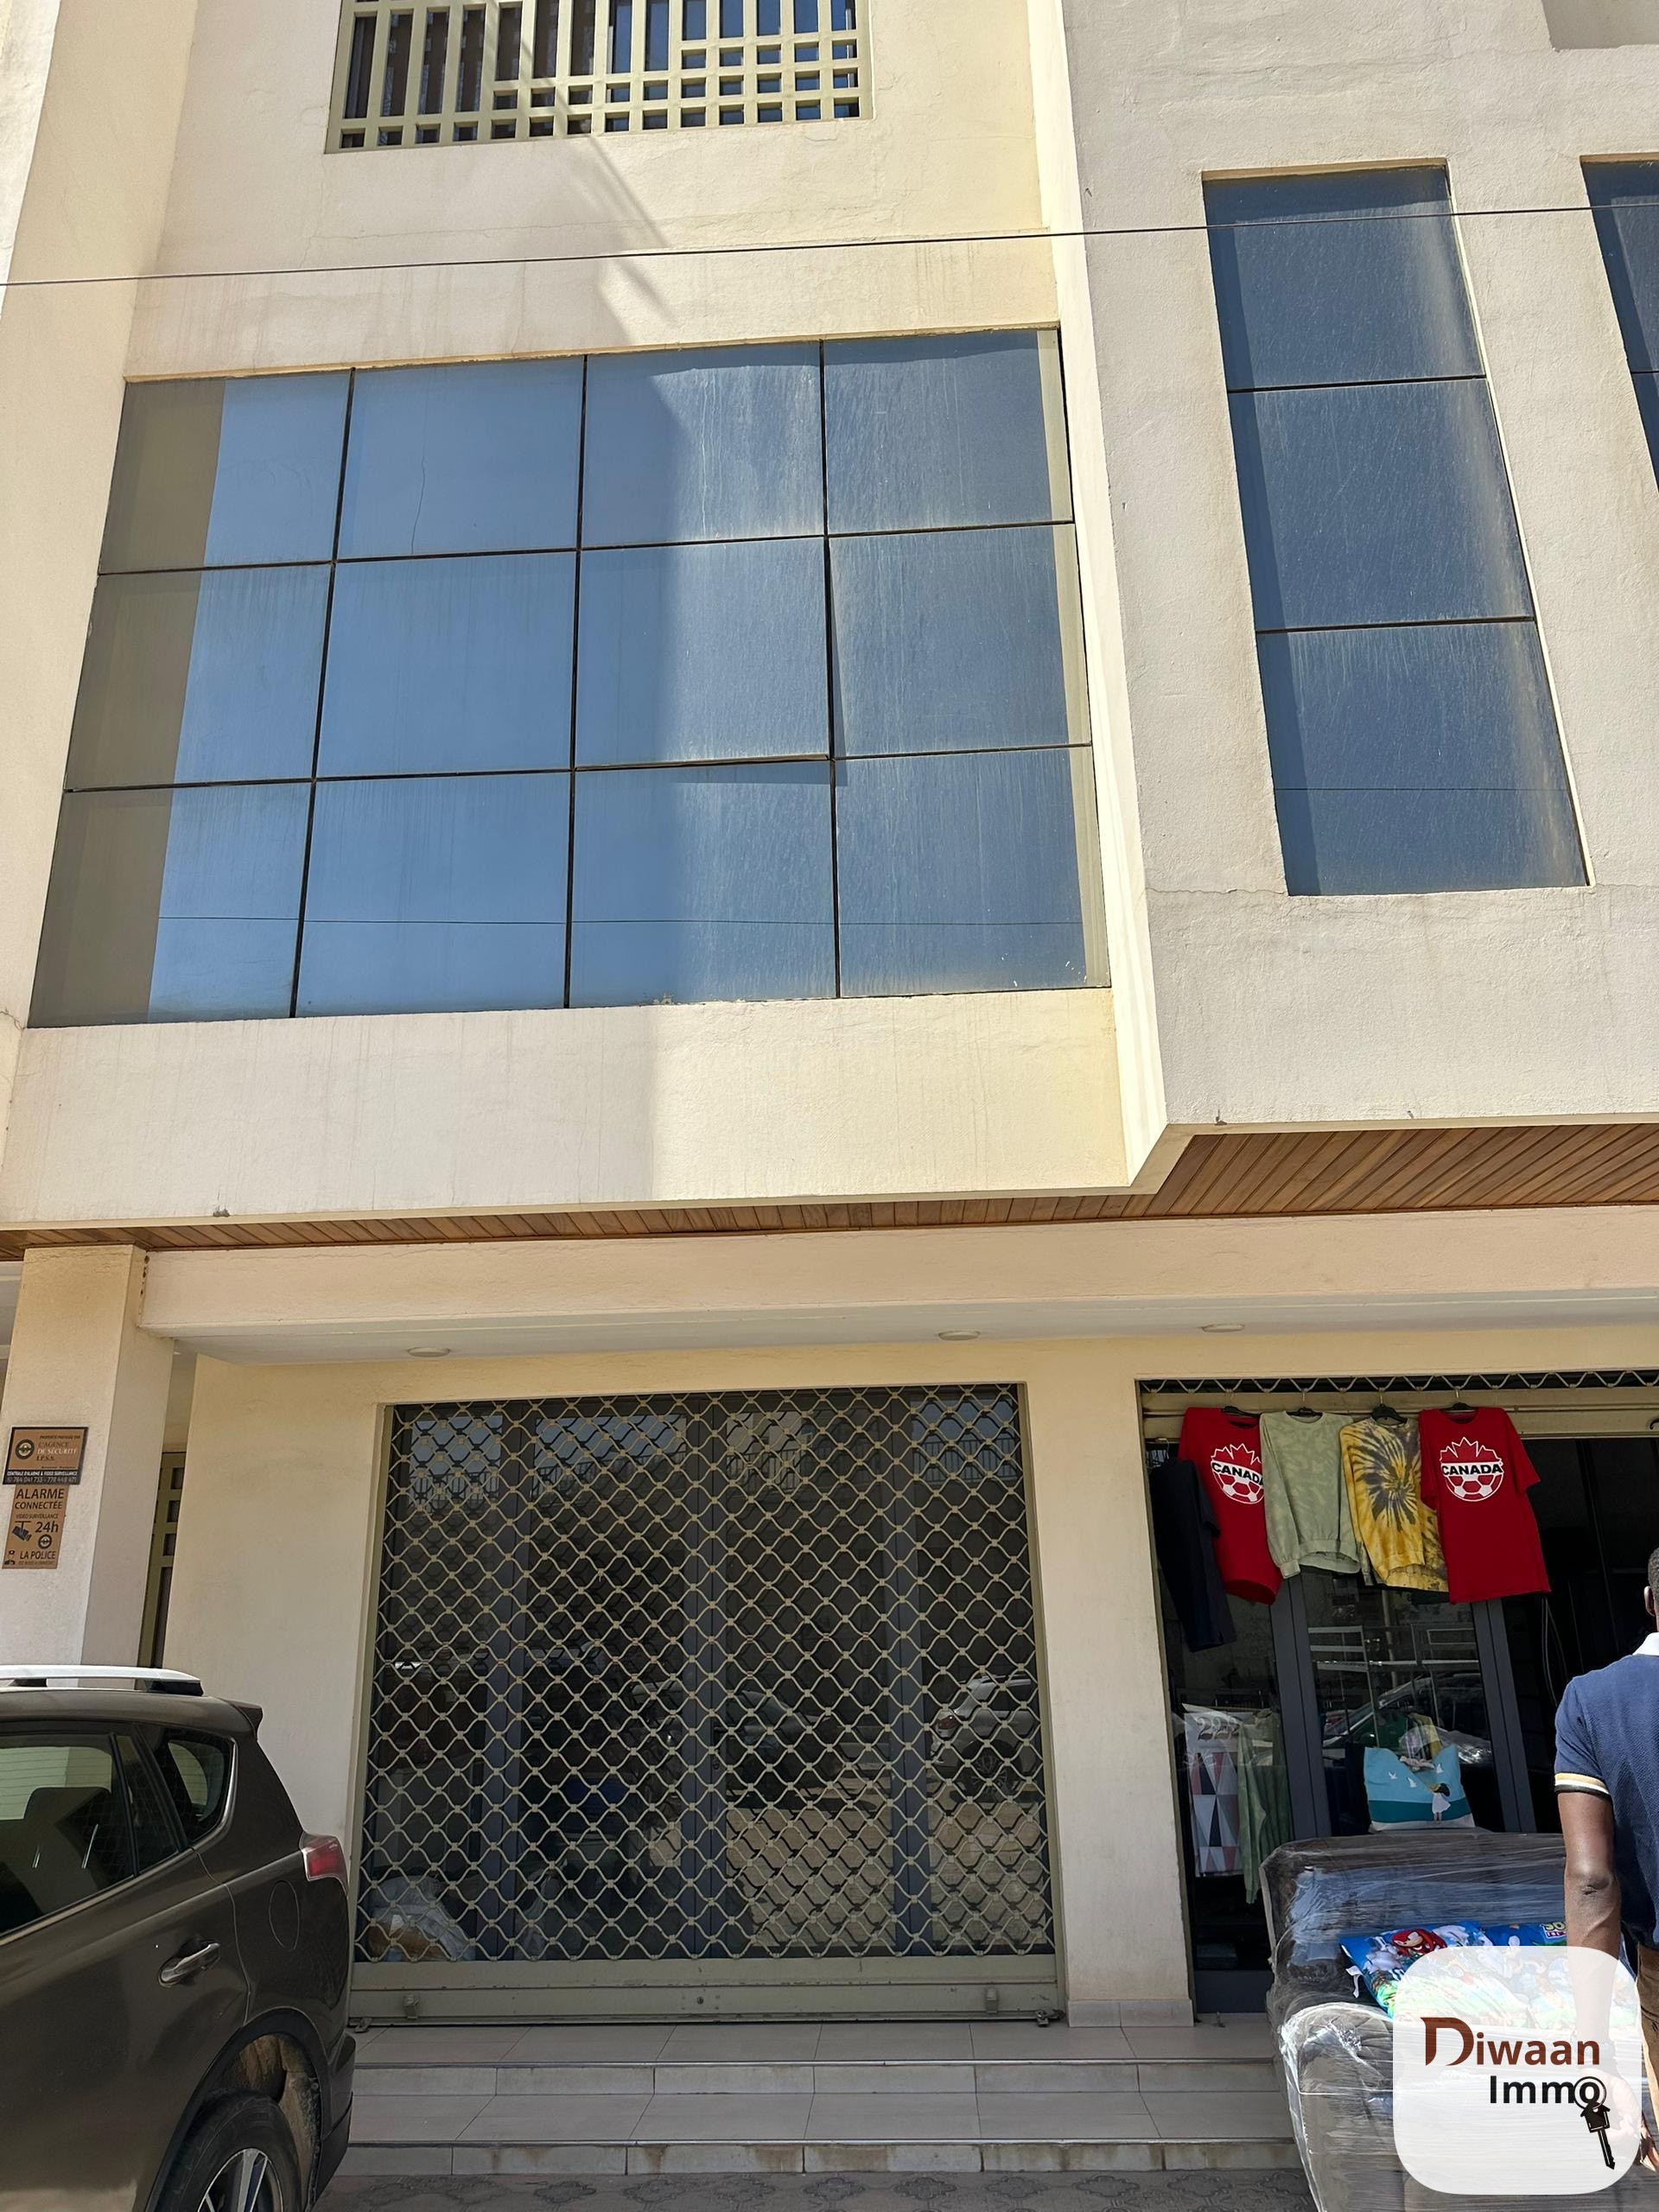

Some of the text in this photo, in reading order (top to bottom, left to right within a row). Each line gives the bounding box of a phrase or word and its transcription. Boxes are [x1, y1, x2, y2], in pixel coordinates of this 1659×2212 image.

[1441, 1464, 1503, 1475] CANADA
[16, 1488, 65, 1499] ALARME
[15, 1500, 63, 1510] CONNECTÉE
[35, 1521, 59, 1533] 24h
